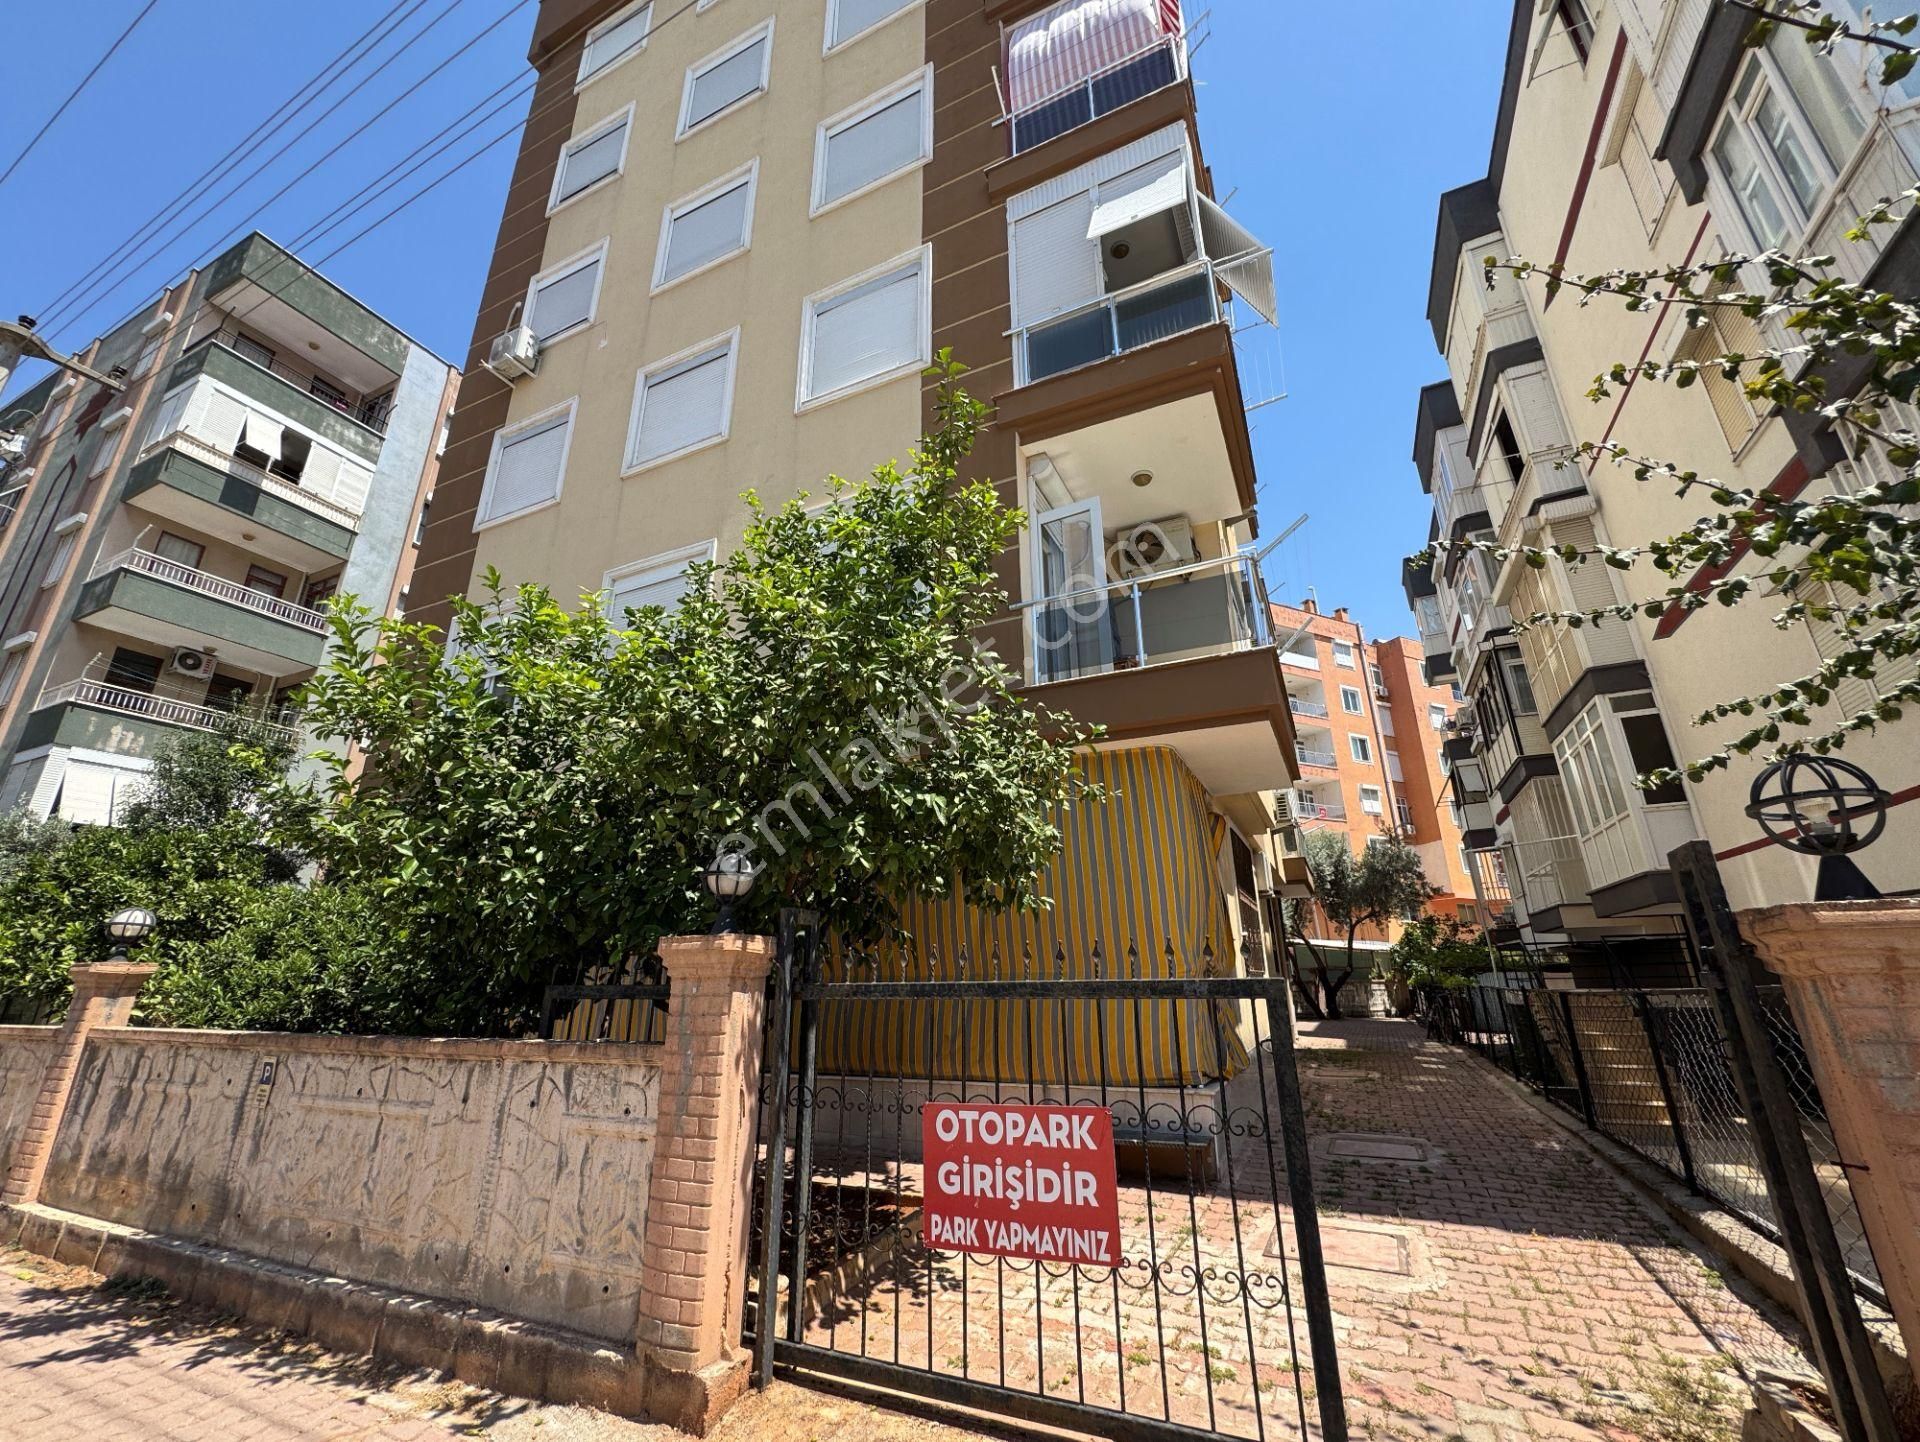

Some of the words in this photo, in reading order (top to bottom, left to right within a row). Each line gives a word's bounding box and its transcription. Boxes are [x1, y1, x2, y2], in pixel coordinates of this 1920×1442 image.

[936, 1109, 1098, 1150] OTOPARK
[938, 1155, 1099, 1210] GİRİŞİDİR
[931, 1214, 979, 1247] PARK
[984, 1219, 1111, 1262] YAPMAYINIZ
